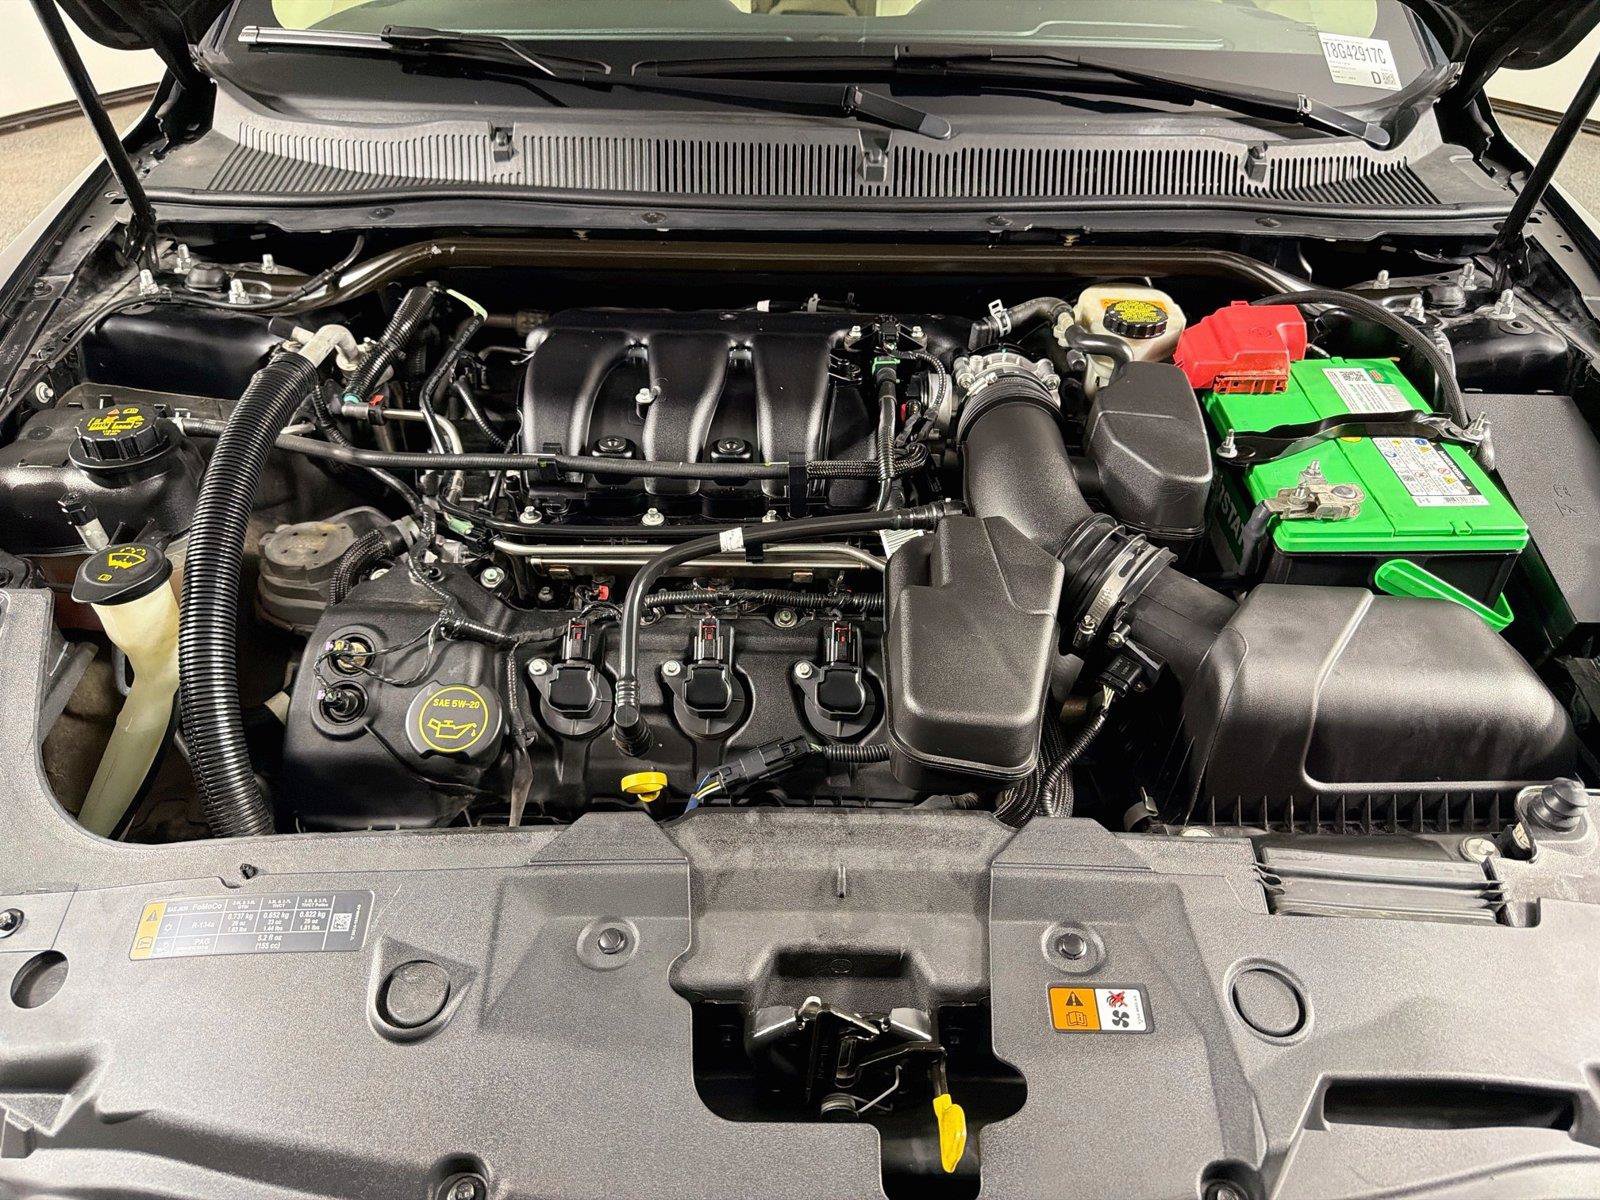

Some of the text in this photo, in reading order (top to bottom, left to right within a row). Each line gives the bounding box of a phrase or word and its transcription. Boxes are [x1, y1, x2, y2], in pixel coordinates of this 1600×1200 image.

[1322, 41, 1386, 64] T8G42917C
[1371, 72, 1381, 84] D
[433, 698, 480, 709] SAE 5W-20
[192, 902, 223, 911] FoMoCo
[245, 912, 254, 921] kg
[281, 911, 290, 919] kg
